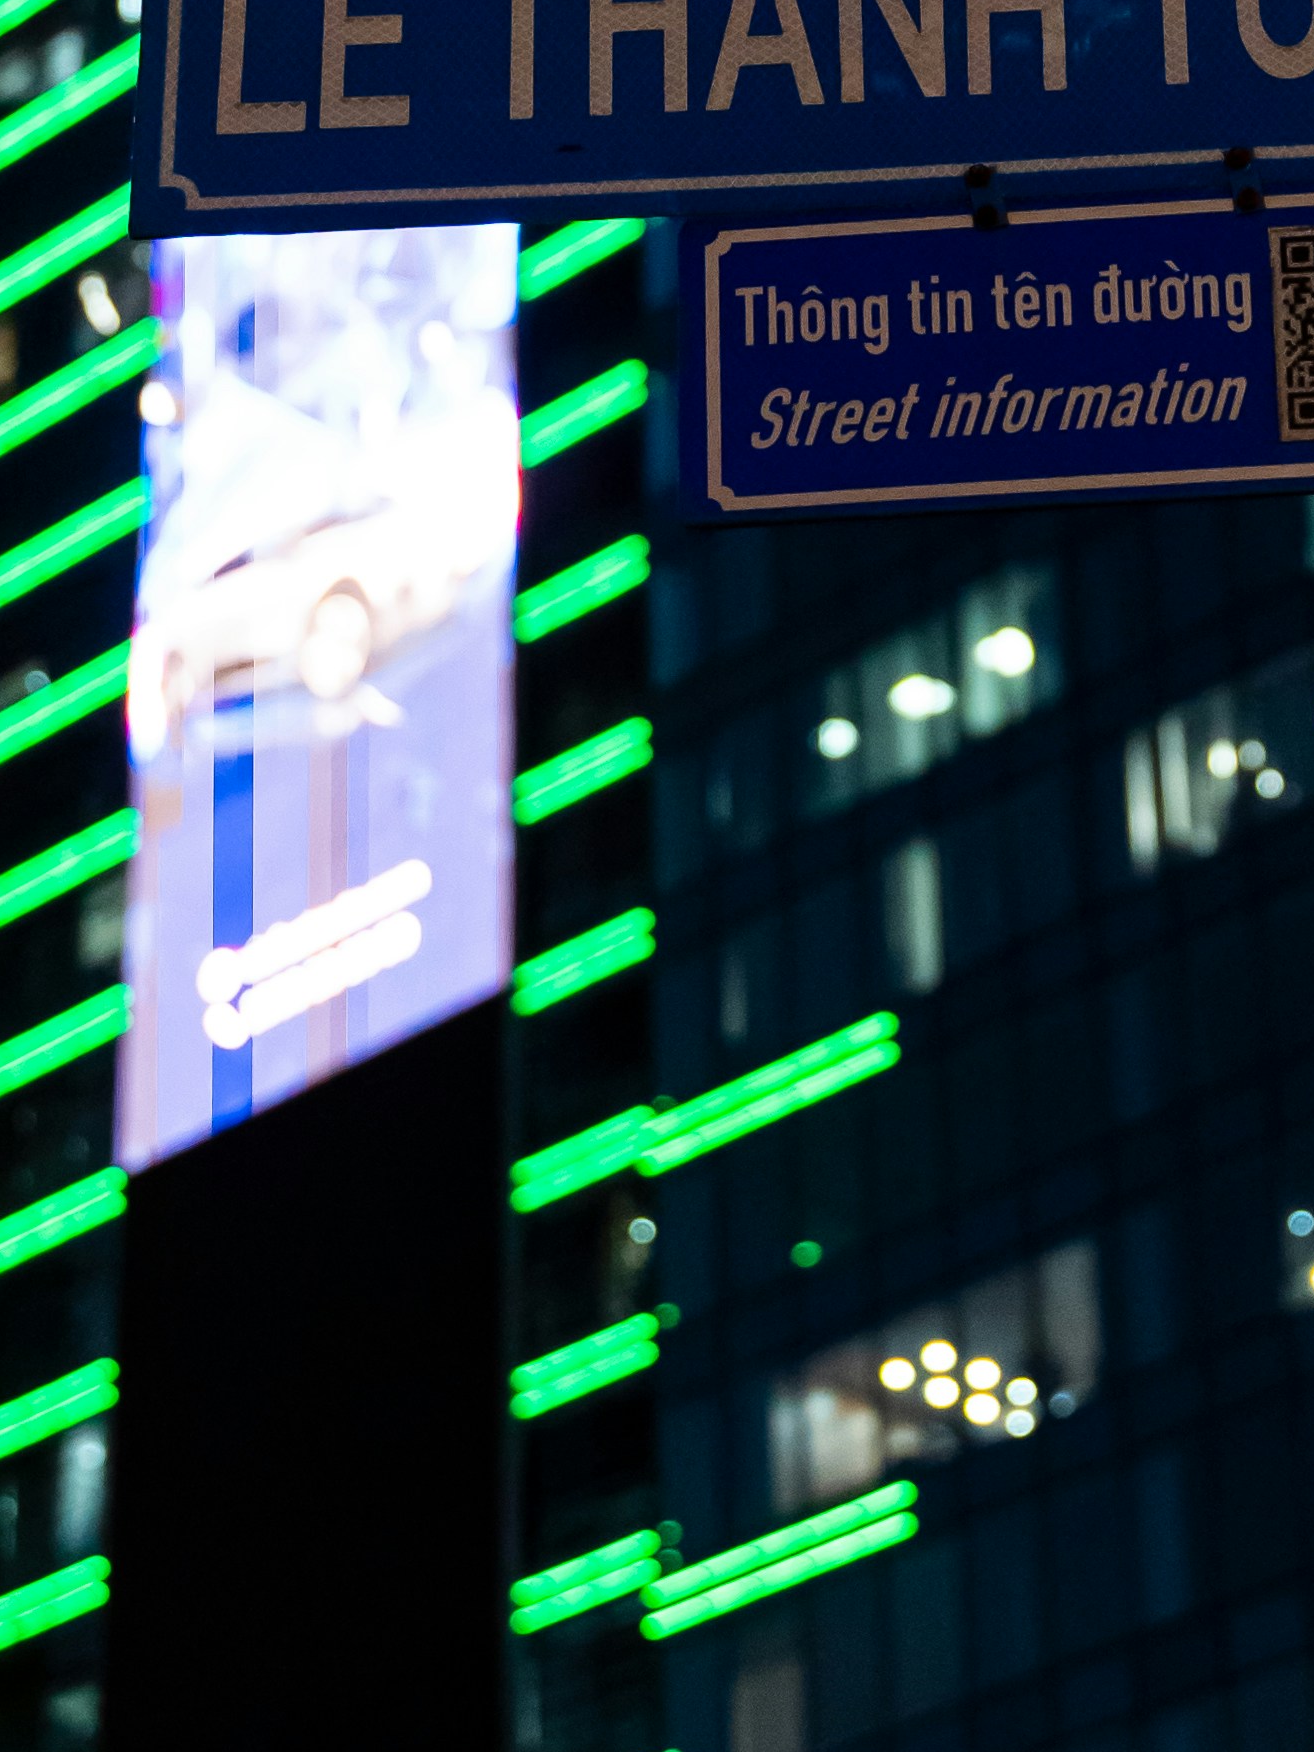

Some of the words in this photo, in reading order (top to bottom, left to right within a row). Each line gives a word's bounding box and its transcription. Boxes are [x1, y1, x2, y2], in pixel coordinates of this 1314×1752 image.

[734, 284, 890, 354] Thông
[907, 276, 973, 334] tin
[990, 272, 1073, 330] tên
[1092, 259, 1254, 333] đường
[750, 383, 920, 450] Street
[929, 362, 1248, 438] information
